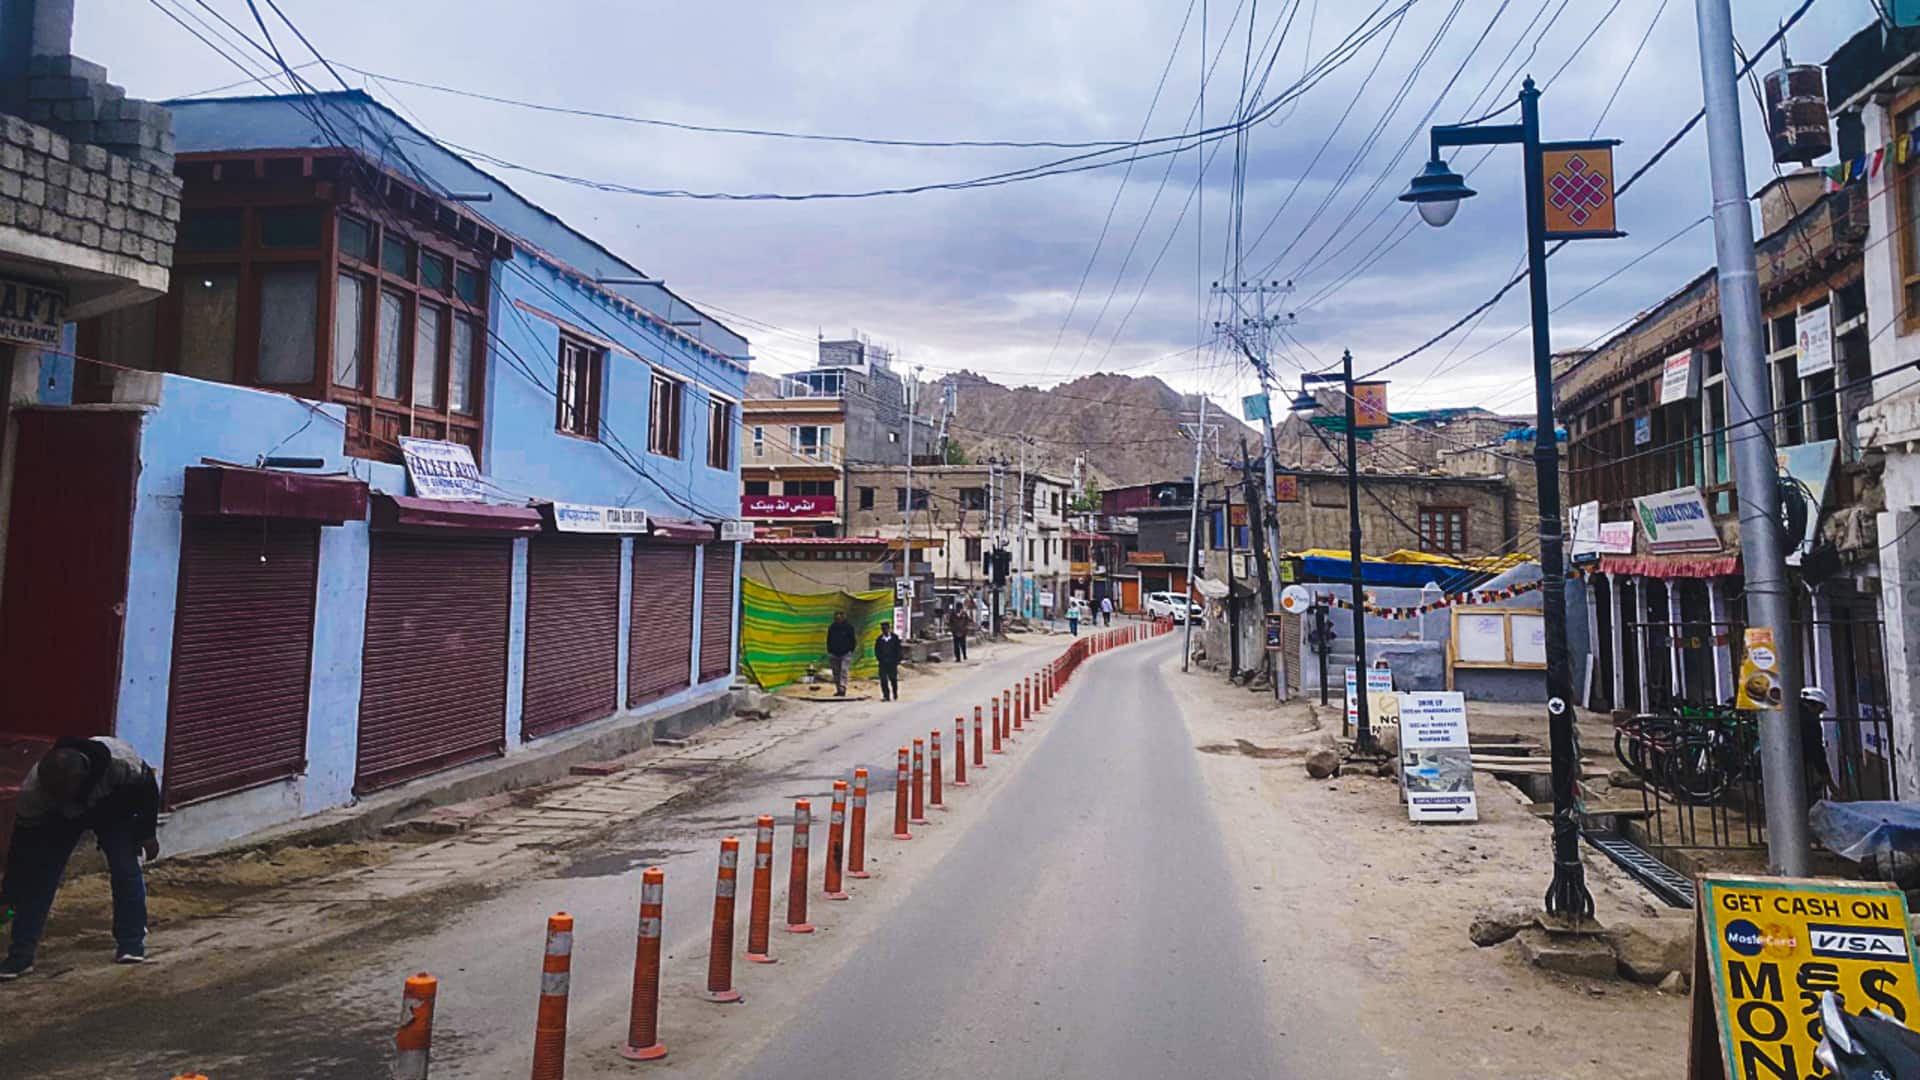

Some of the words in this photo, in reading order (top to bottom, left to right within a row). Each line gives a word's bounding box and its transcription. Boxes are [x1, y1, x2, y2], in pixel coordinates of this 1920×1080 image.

[1722, 893, 1763, 913] GET
[1774, 896, 1841, 918] CASH
[1851, 901, 1890, 920] ON
[1818, 933, 1893, 953] VISA
